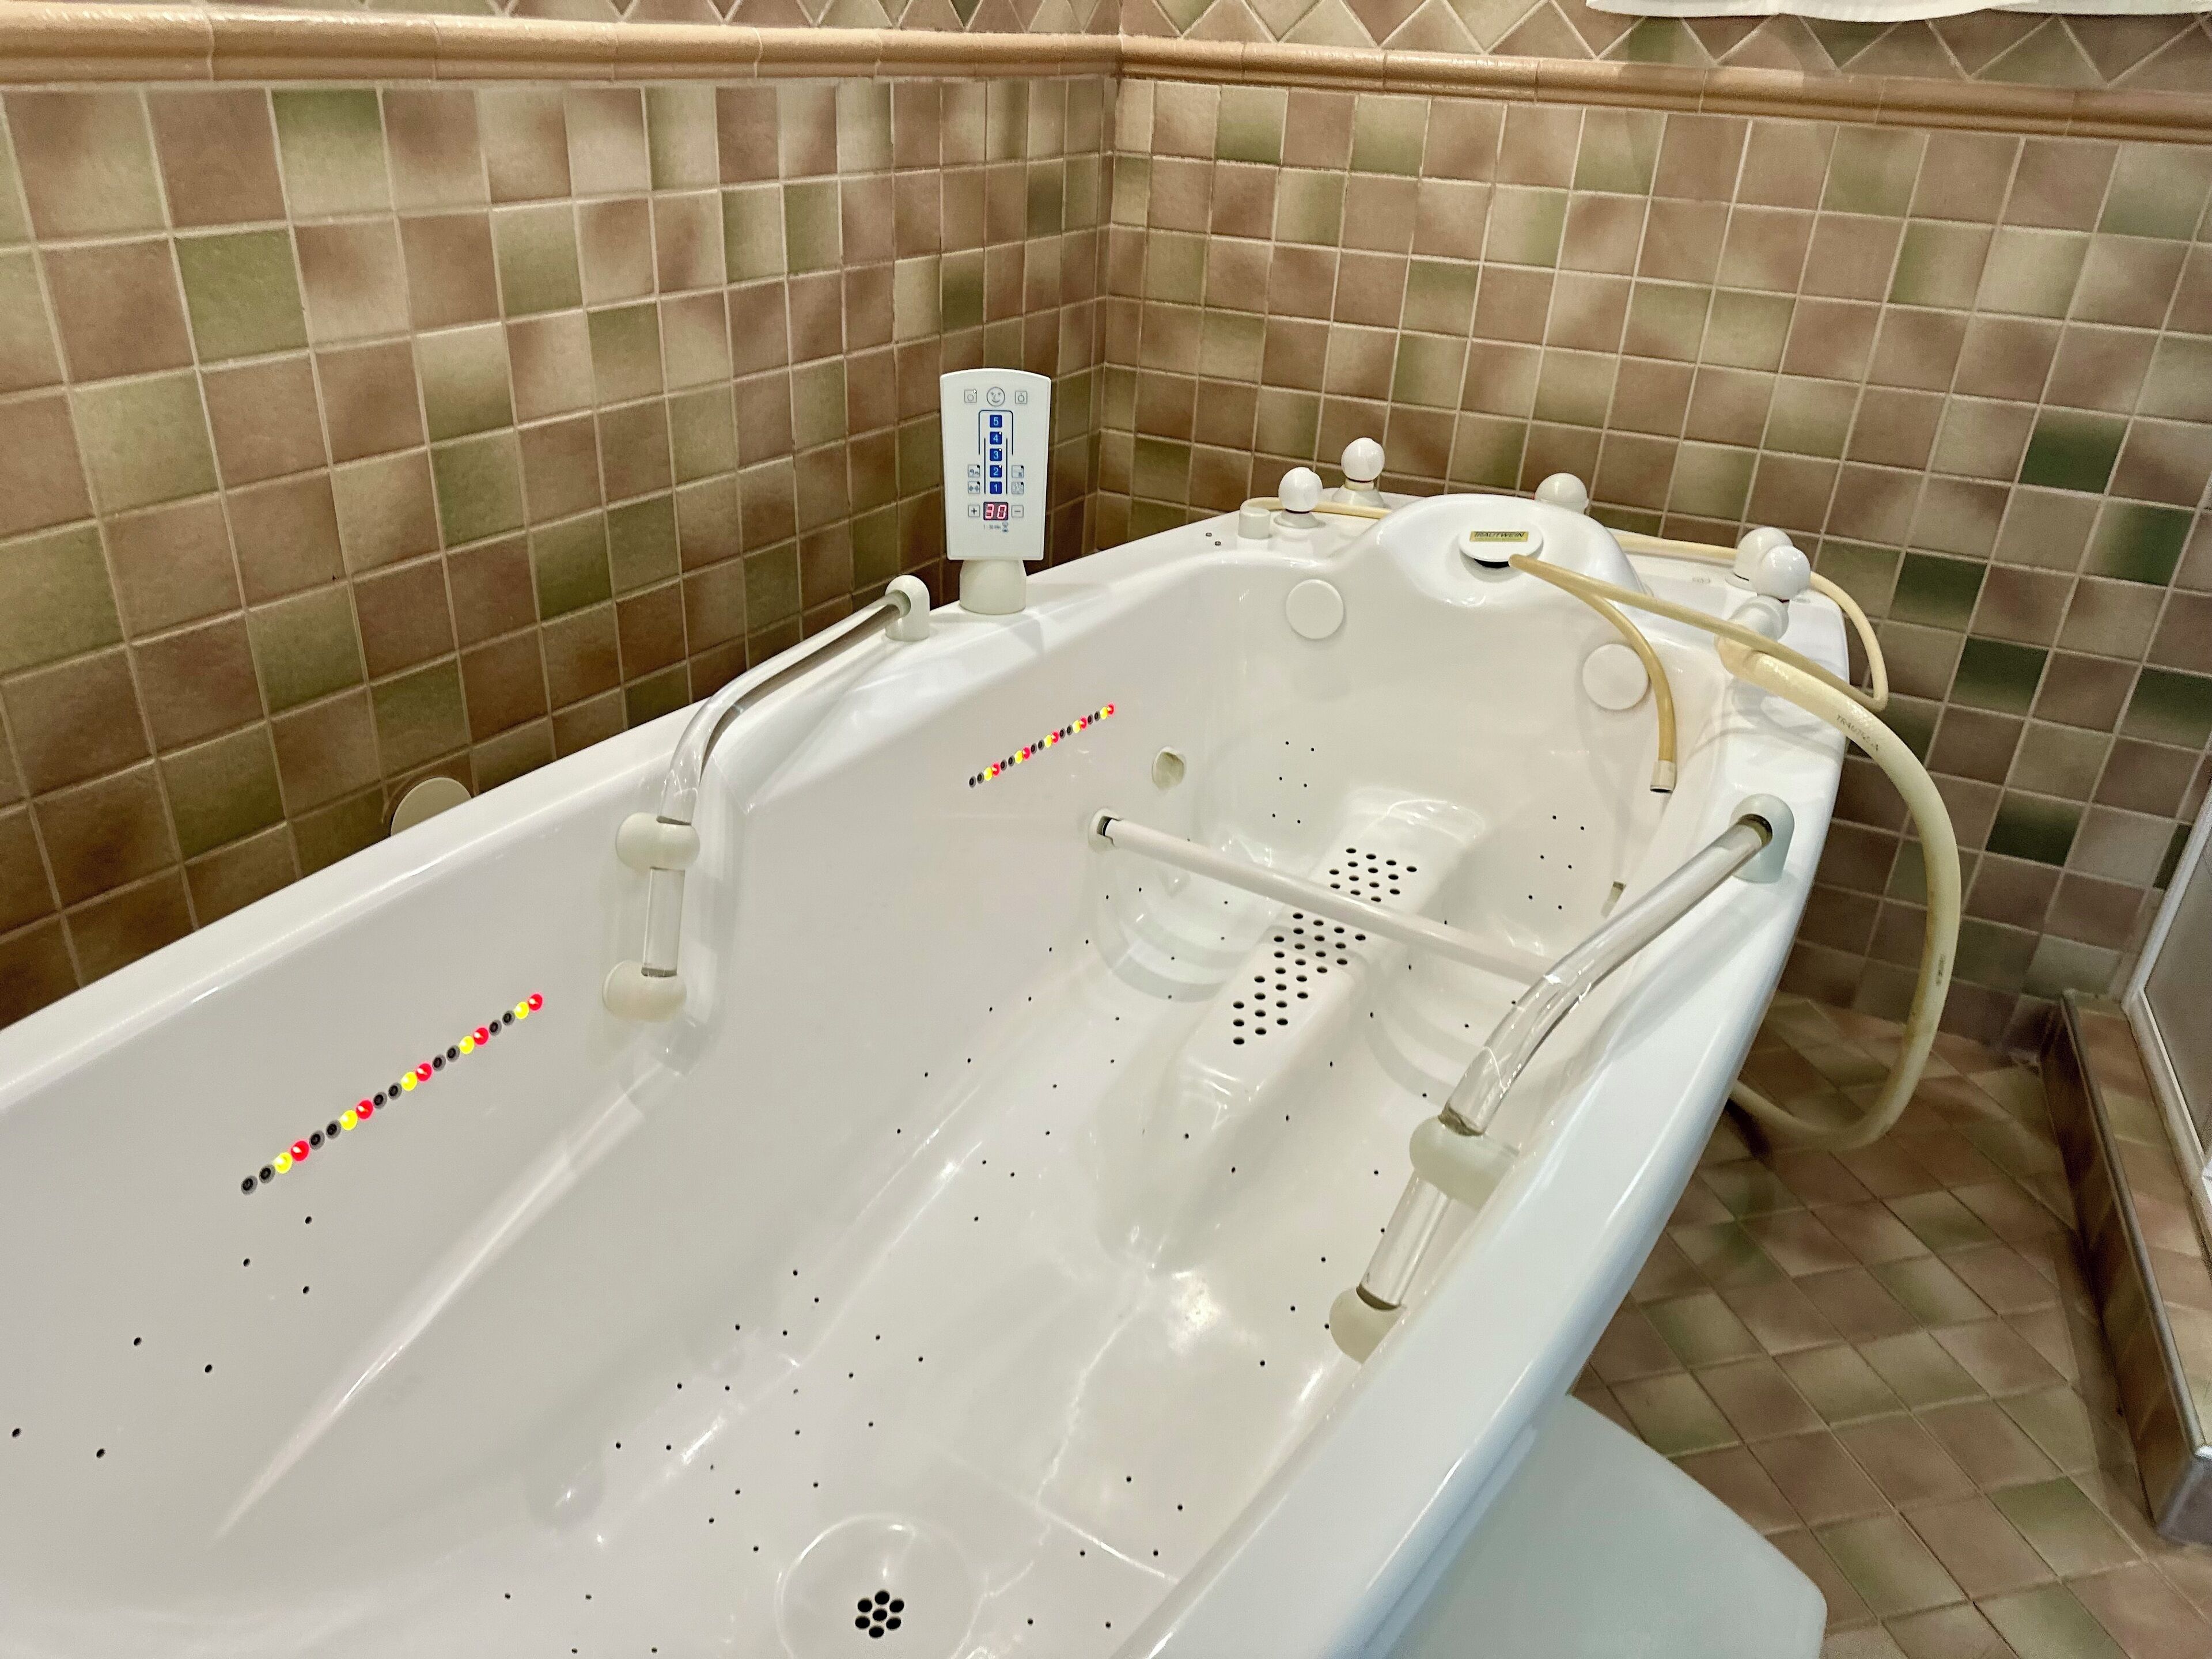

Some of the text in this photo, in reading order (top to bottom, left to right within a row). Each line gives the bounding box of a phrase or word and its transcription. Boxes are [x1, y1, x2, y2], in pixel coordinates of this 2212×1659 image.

[993, 416, 999, 426] 5
[993, 434, 999, 443] 4
[993, 450, 999, 459] 3
[993, 467, 999, 476] 2
[994, 484, 998, 493] 1
[985, 503, 1007, 519] 30
